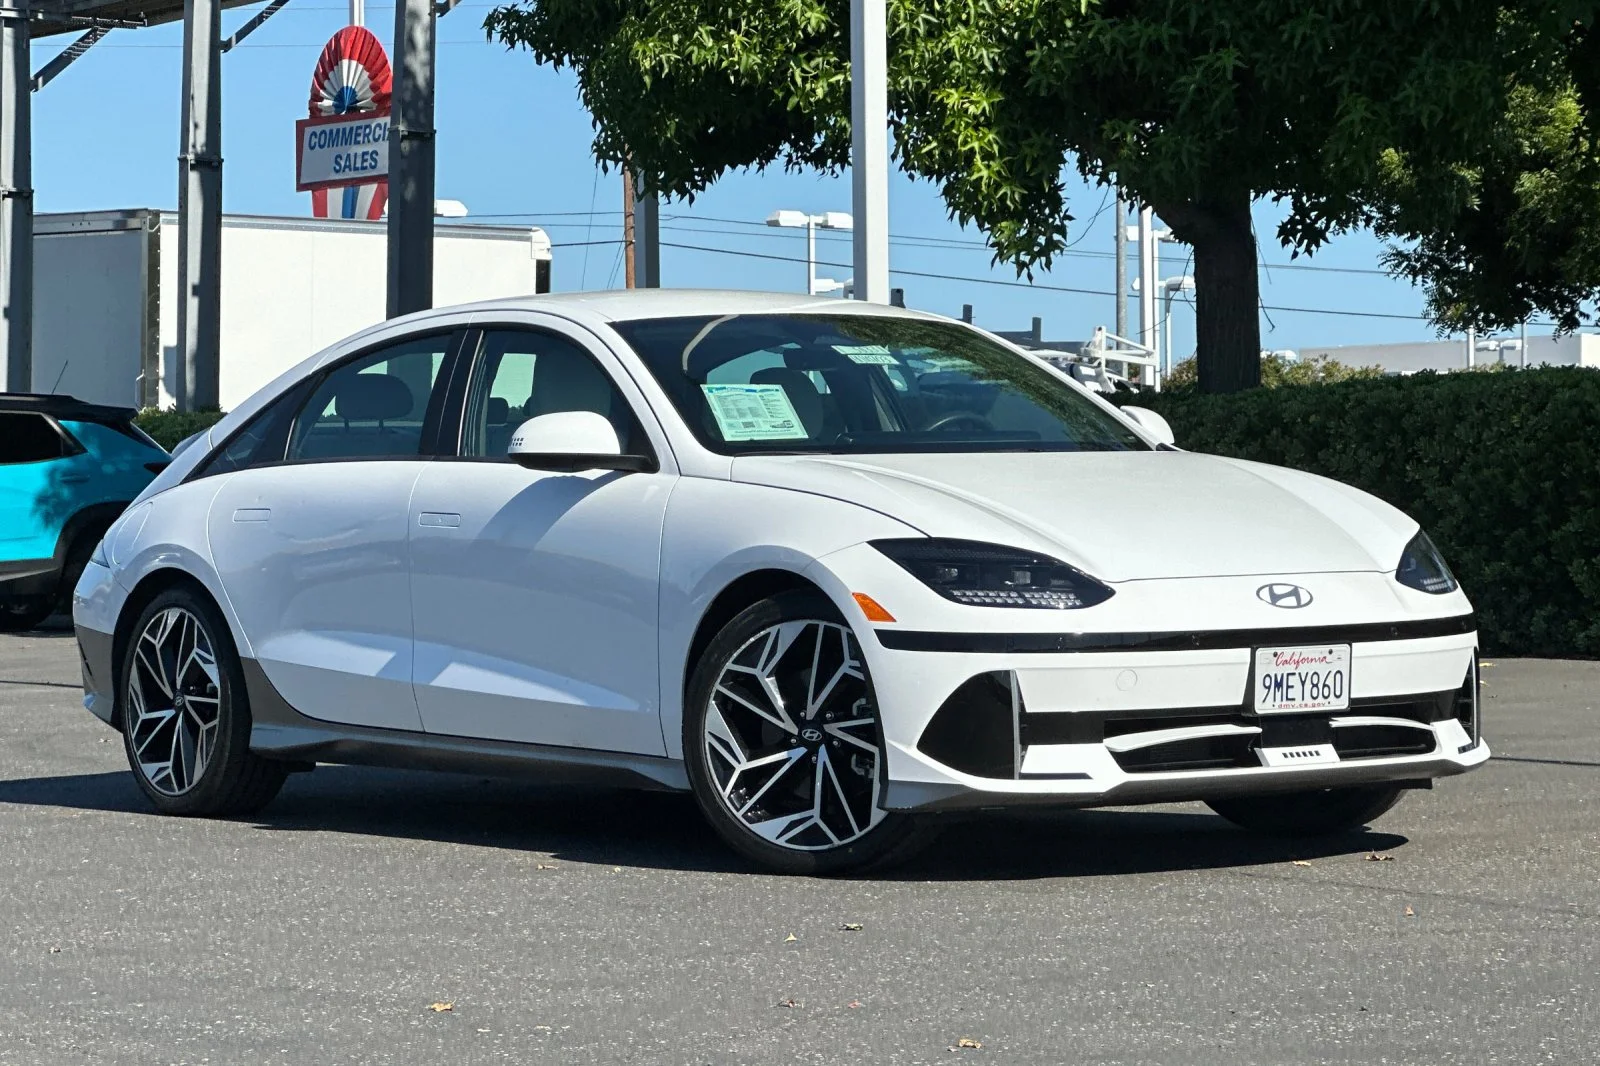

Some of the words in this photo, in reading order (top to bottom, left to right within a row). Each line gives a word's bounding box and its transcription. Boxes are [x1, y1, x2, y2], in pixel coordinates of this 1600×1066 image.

[308, 122, 389, 151] COMMERCI
[333, 150, 379, 173] SALES
[1276, 652, 1333, 670] California
[1262, 670, 1343, 703] 9MEY860
